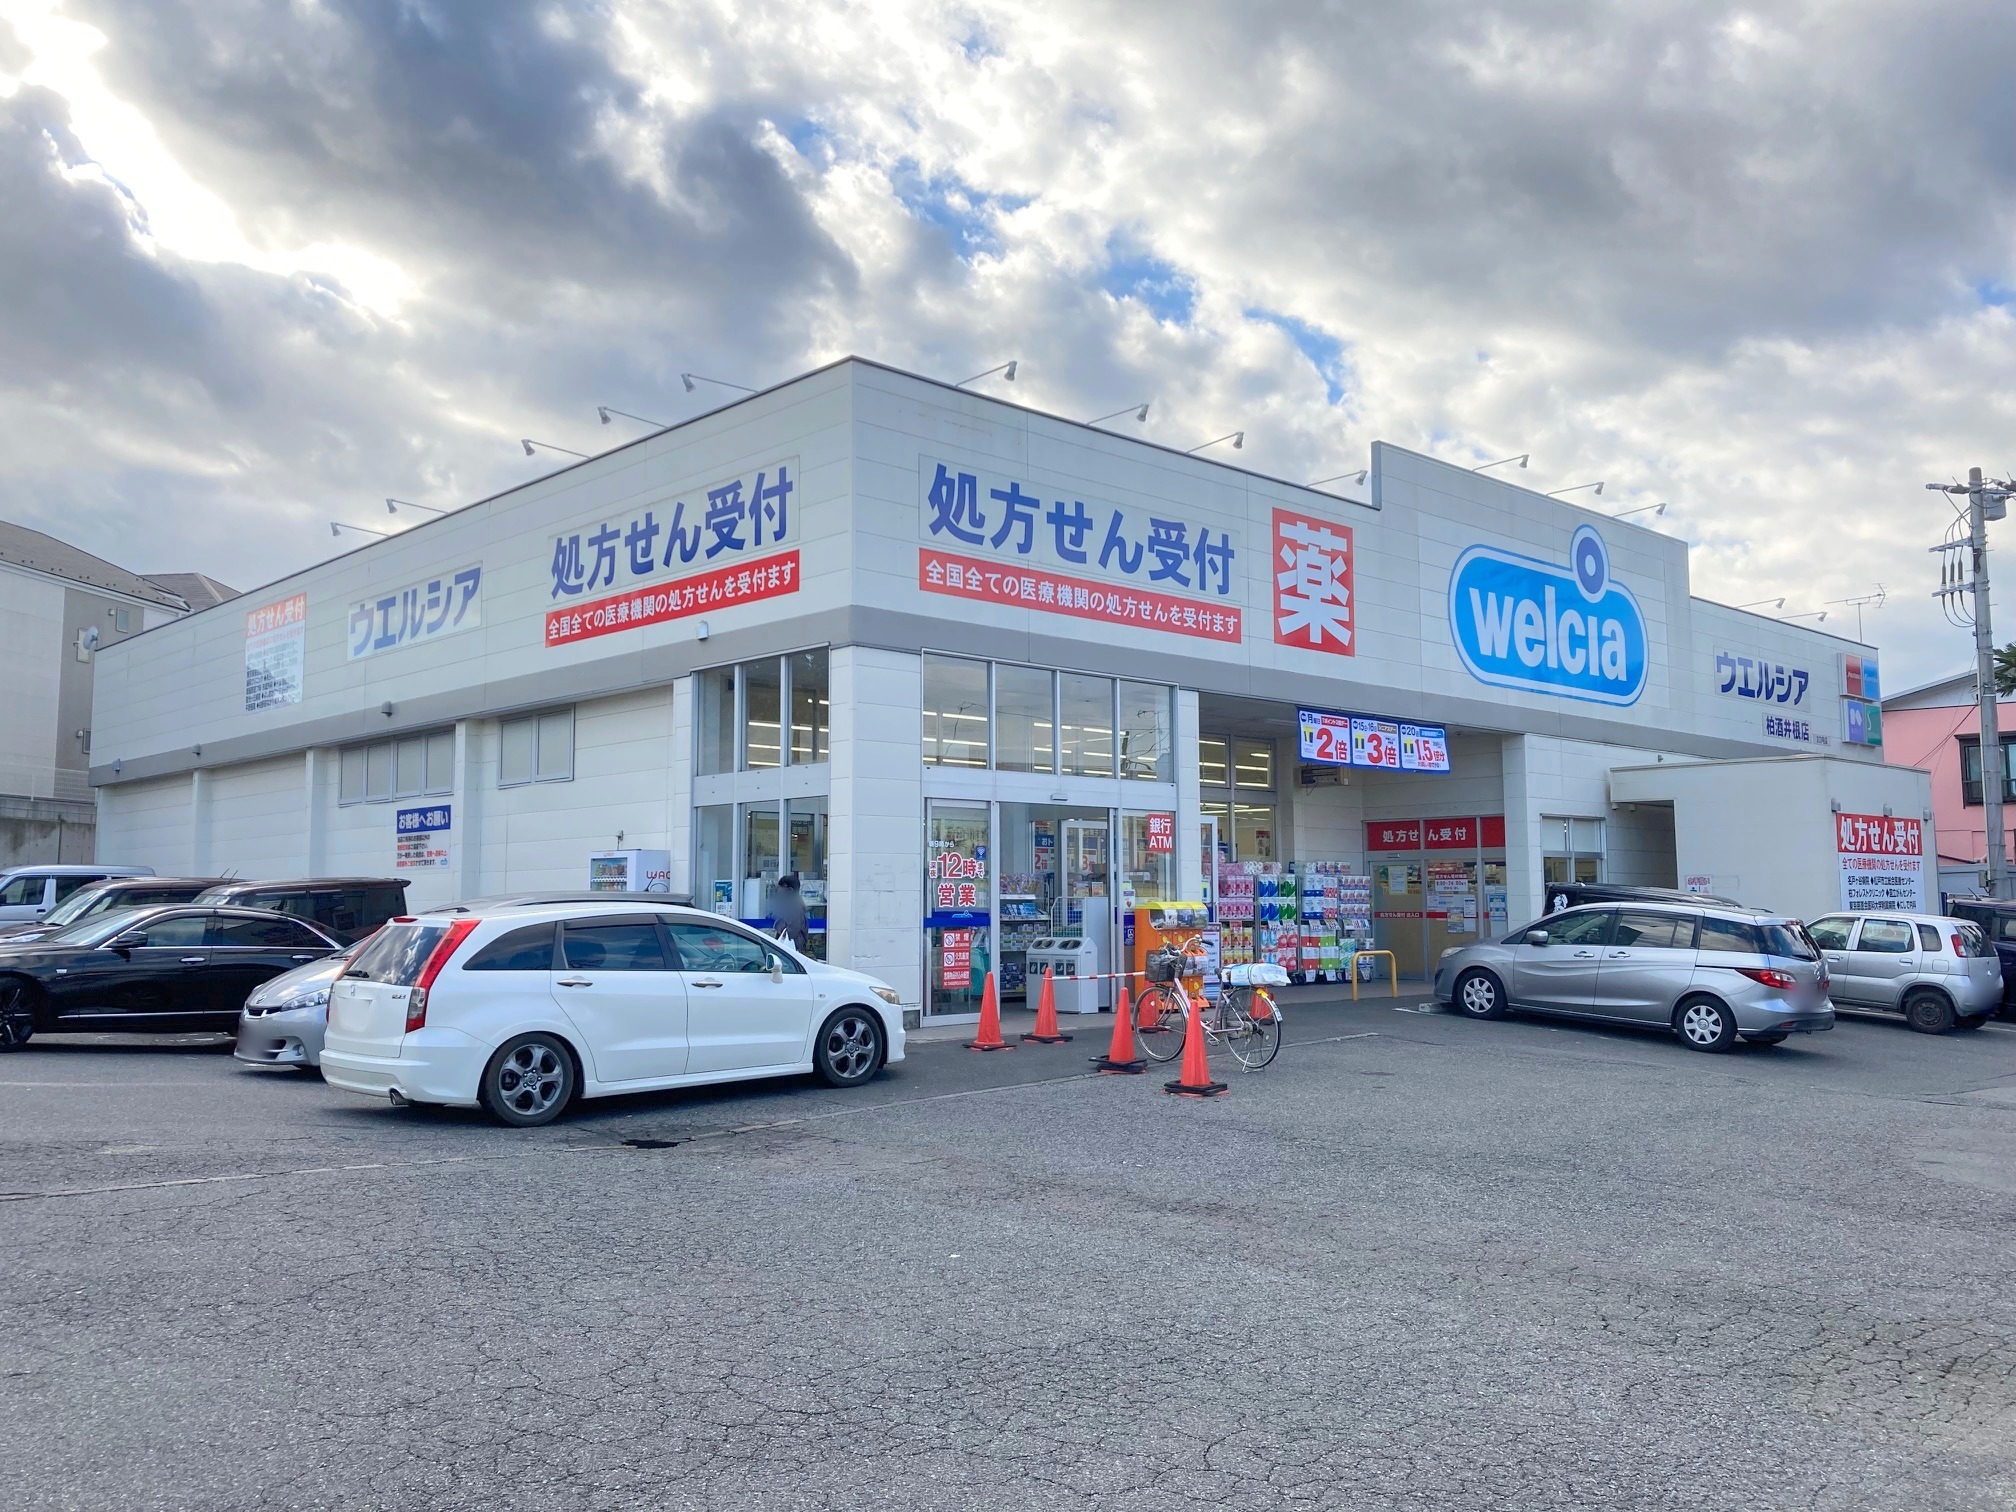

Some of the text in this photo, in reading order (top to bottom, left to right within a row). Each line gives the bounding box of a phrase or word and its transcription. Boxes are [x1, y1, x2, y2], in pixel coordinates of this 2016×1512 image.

[551, 466, 793, 600] 処方せん受付
[928, 463, 1235, 595] 処方せん受付
[548, 560, 796, 640] 全国全ての医療機関の処方せんを受付ます
[925, 559, 1238, 635] 全国全ての医療機関の処方せんを受付ます
[1277, 521, 1352, 646] 薬
[247, 596, 305, 636] 処方せん受付
[350, 566, 481, 657] ウエルシア
[1469, 586, 1627, 682] welcia
[1716, 651, 1809, 706] ウエルシア
[1766, 715, 1811, 741] 柏酒井根店
[398, 810, 449, 829] お客様へお願い
[1149, 817, 1172, 834] 銀行
[1149, 836, 1173, 849] ATM
[1382, 827, 1467, 843] 処方せん受付
[1840, 815, 1919, 855] 処方せん受付
[938, 883, 977, 907] 営業
